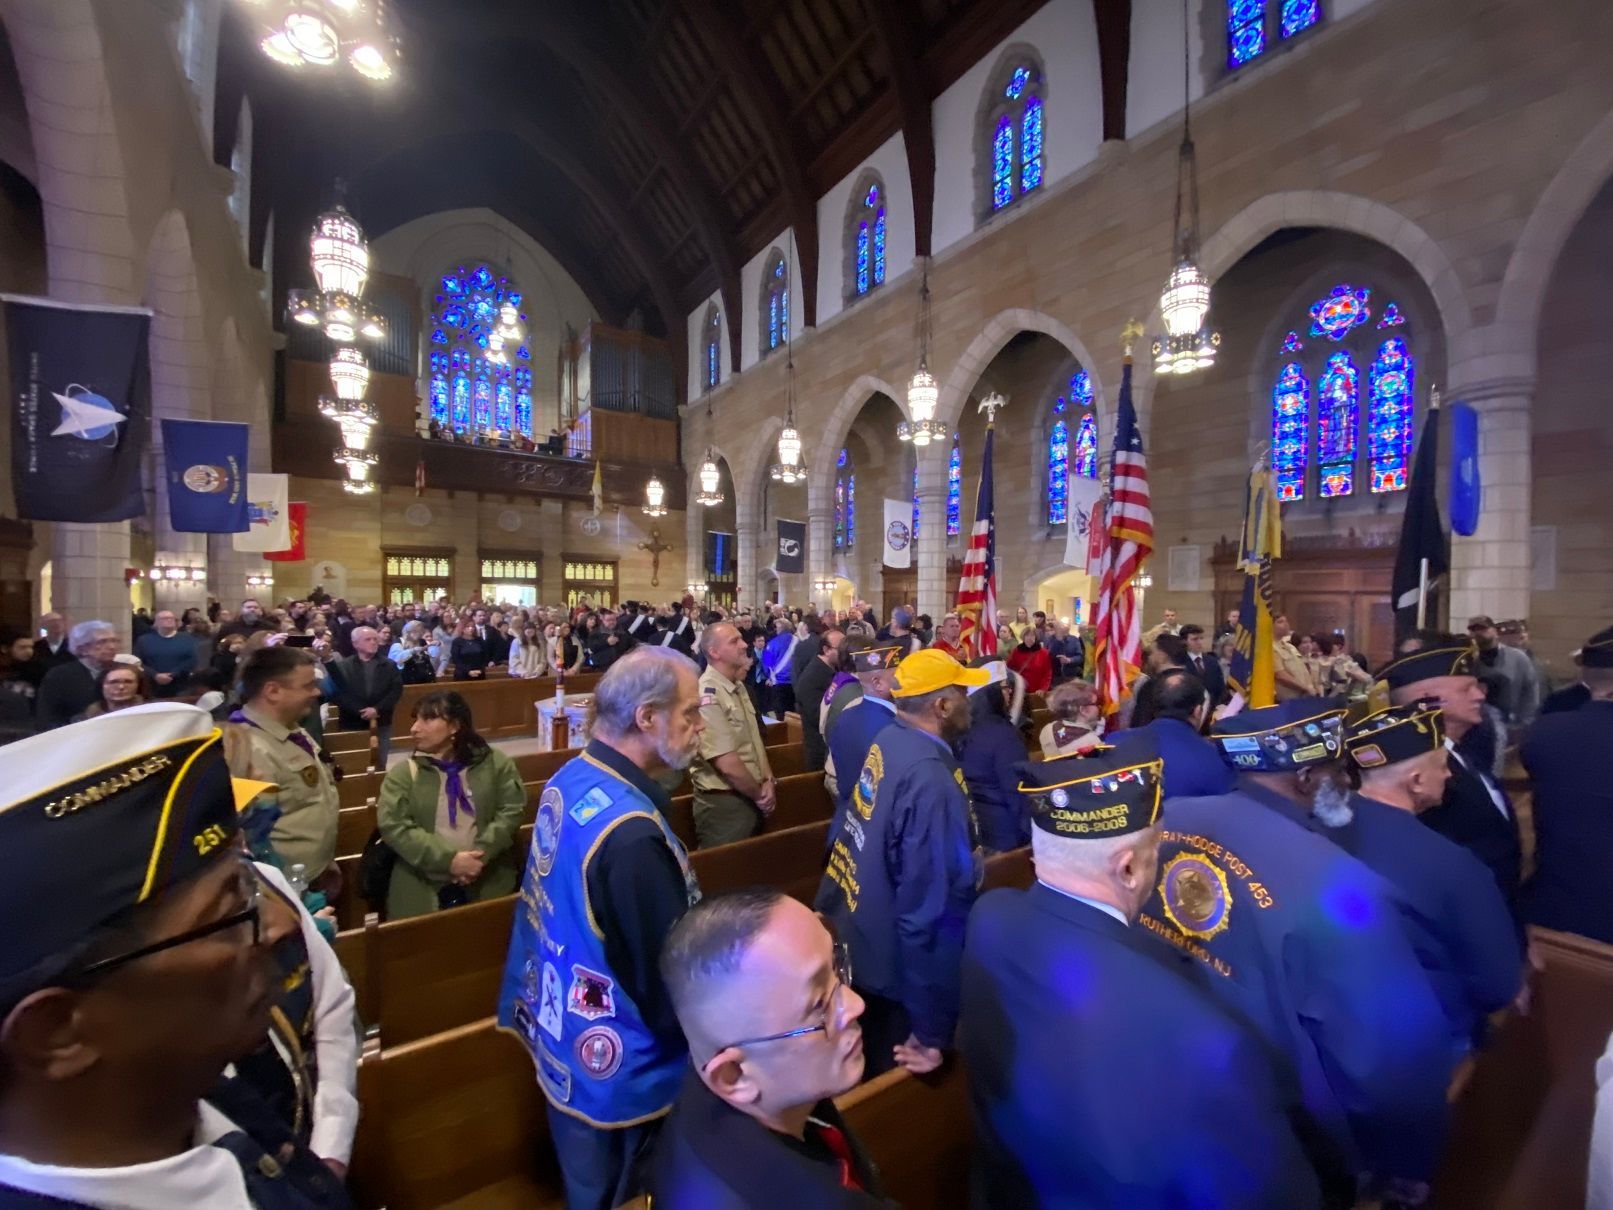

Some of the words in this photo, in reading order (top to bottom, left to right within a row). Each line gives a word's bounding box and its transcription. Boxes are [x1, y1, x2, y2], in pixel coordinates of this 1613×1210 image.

[45, 755, 171, 818] COMMANDER
[1050, 803, 1129, 821] COMMANDER
[194, 824, 226, 855] 251
[1223, 851, 1253, 880] POST
[1248, 881, 1273, 909] 453
[1213, 957, 1232, 977] NJ
